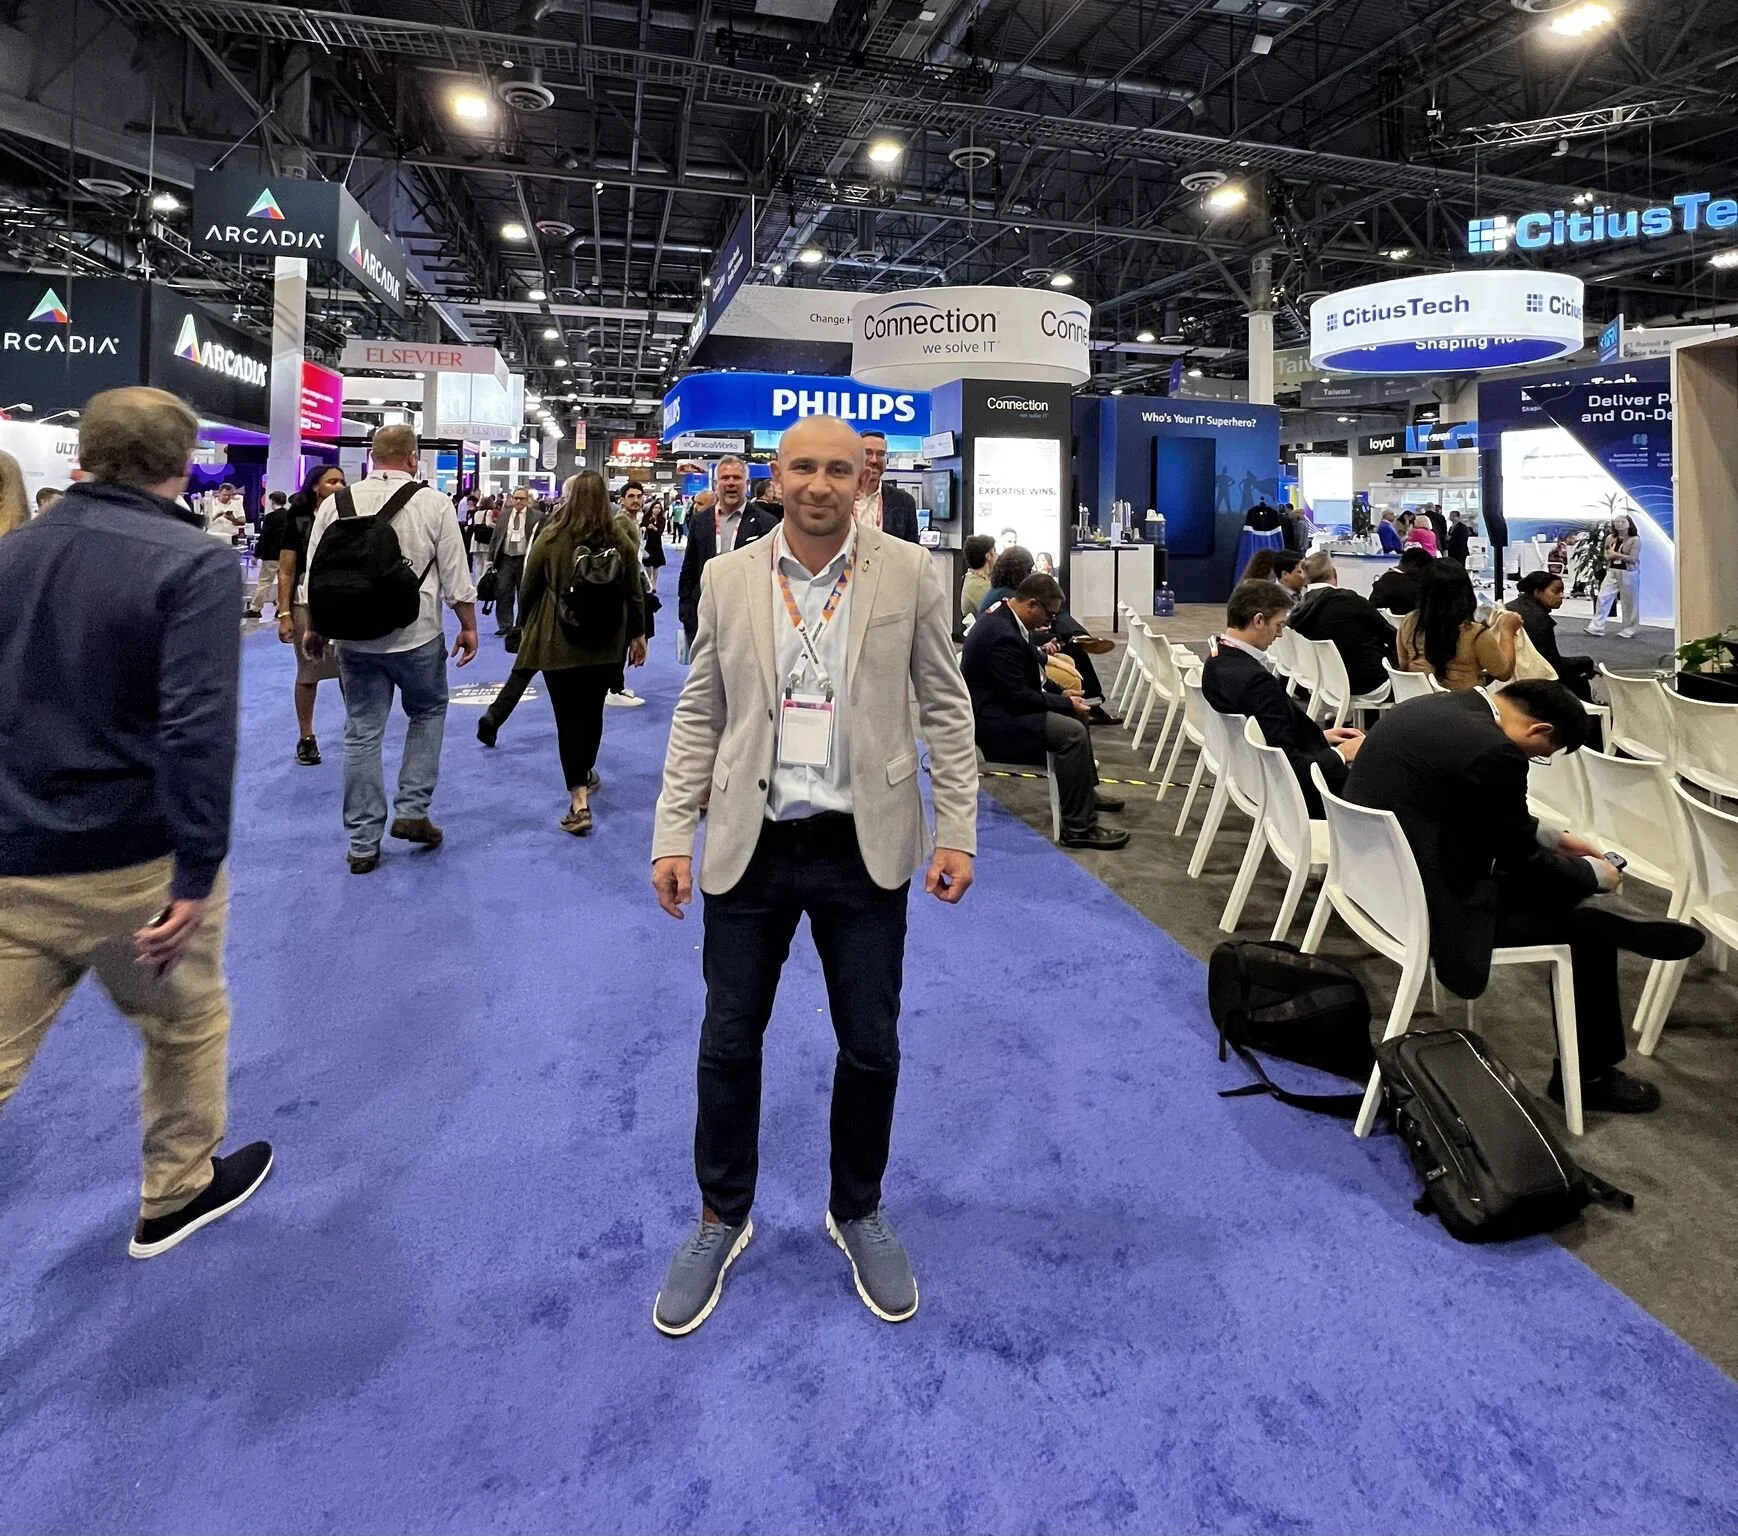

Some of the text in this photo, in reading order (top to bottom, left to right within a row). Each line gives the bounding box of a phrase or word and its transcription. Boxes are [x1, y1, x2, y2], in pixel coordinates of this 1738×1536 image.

[1515, 192, 1738, 248] CitiusTe
[205, 225, 323, 248] ARCADIA
[362, 248, 401, 302] ARCADIA
[809, 313, 845, 325] Change
[1343, 294, 1470, 327] CitiusTech
[864, 307, 997, 341] Connection
[922, 340, 996, 354] we solve IT
[200, 341, 267, 387] ARCADIA
[366, 347, 464, 367] ELSEVIER
[1323, 388, 1351, 396] Taiwan
[1588, 394, 1652, 407] Deliver
[773, 388, 916, 422] PHILIPS
[987, 397, 1049, 411] Connection
[1141, 411, 1257, 428] Who's Your IT Superhero?
[1581, 409, 1615, 423] and
[1369, 436, 1395, 452] loyal
[978, 487, 1027, 496] EXPERTISE
